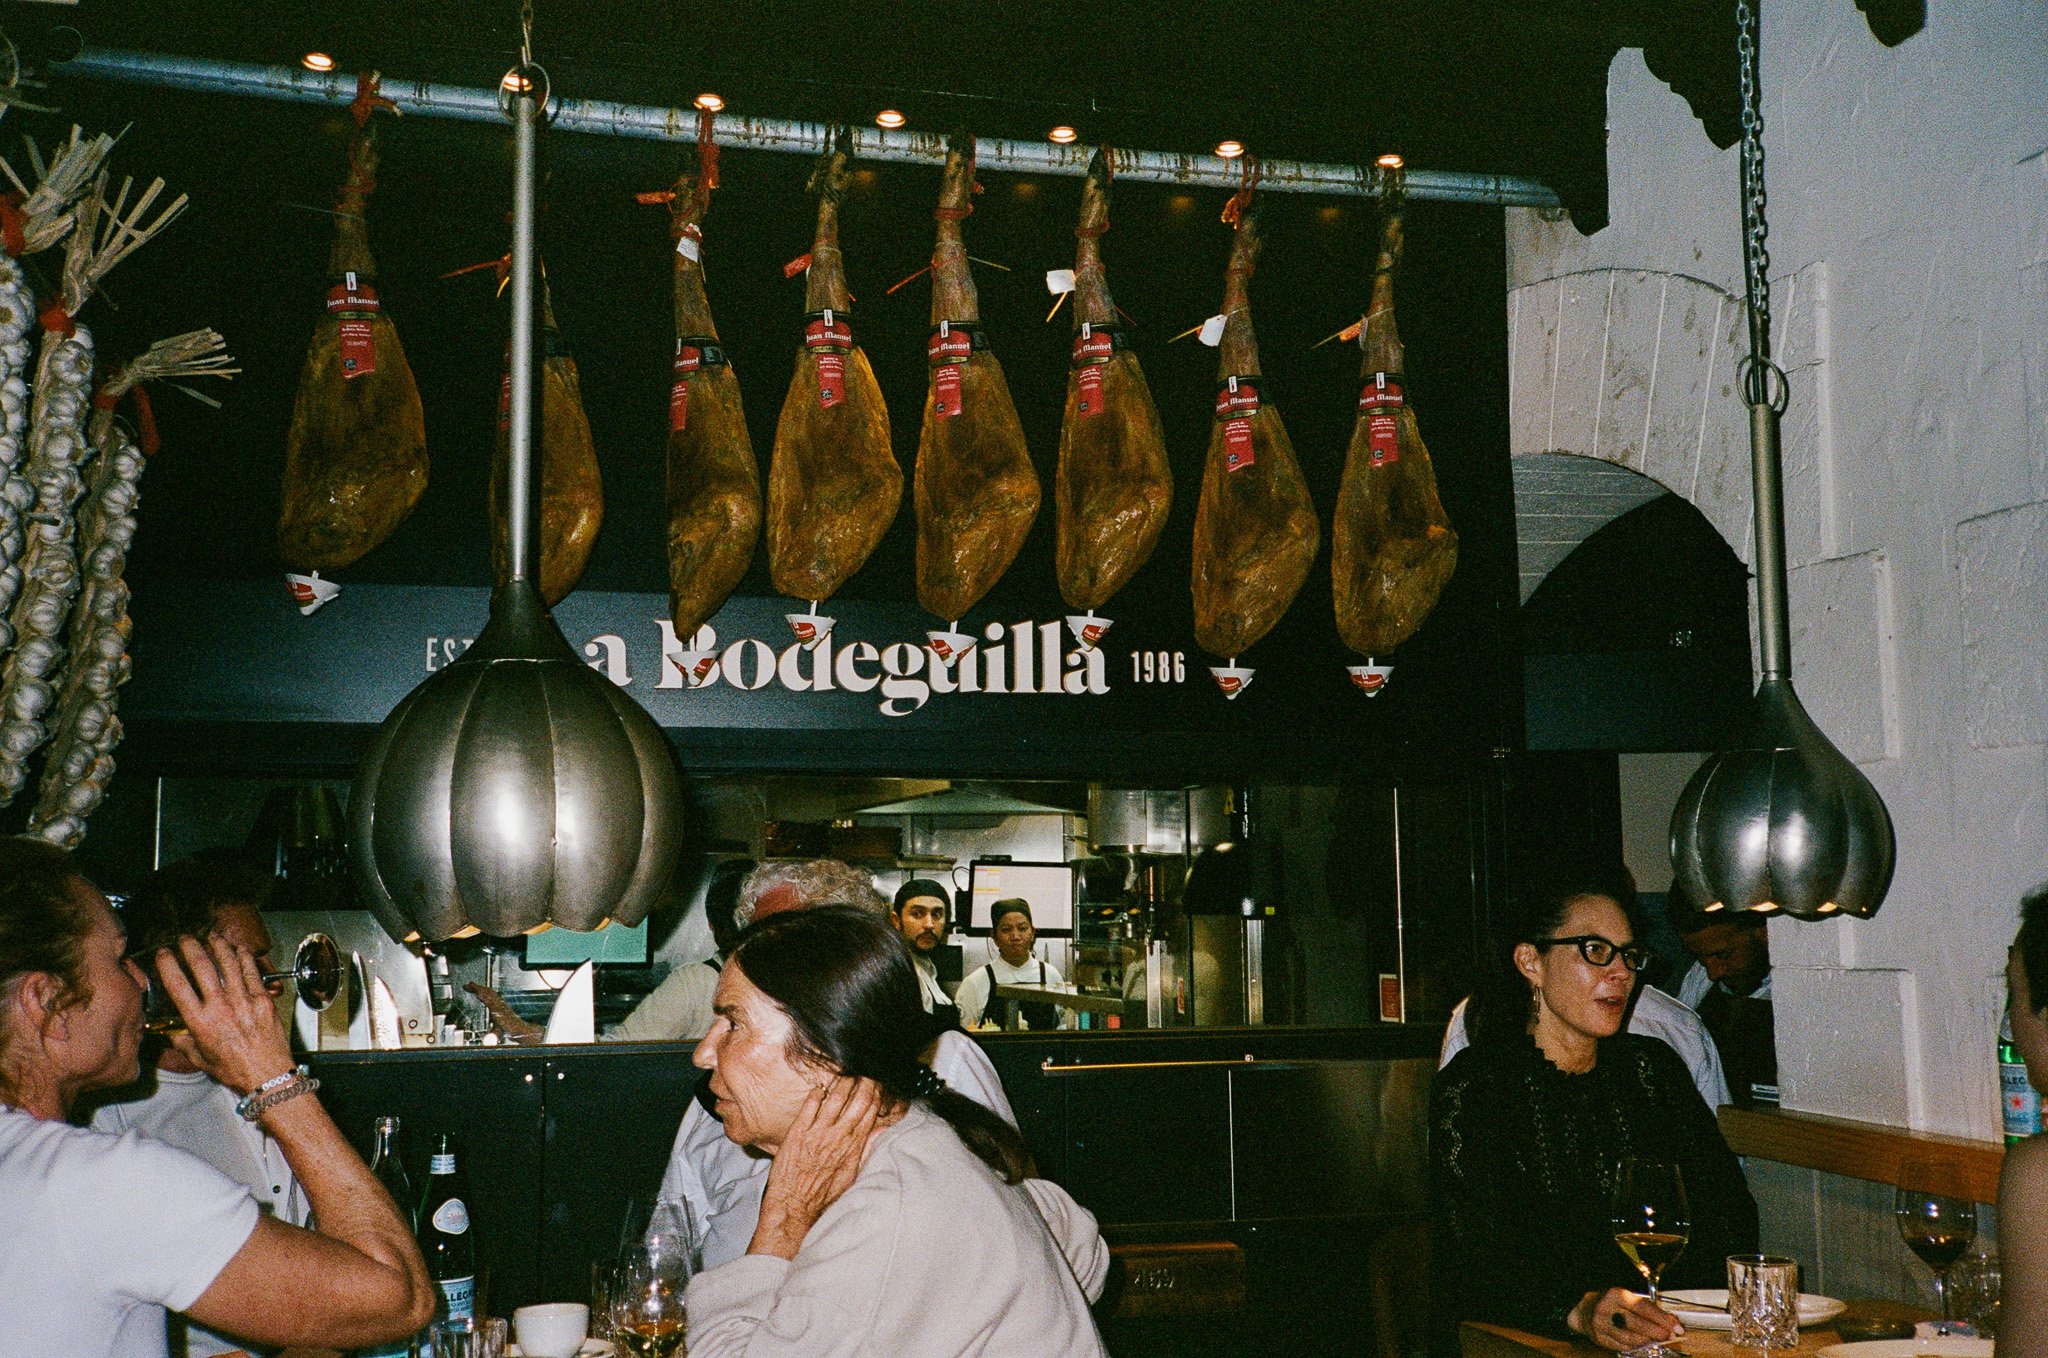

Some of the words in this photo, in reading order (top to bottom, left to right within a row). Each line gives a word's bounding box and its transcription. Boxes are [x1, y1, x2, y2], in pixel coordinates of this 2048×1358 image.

[327, 299, 345, 308] Juan
[806, 334, 823, 343] Juan
[824, 331, 852, 342] Manuel
[940, 342, 970, 351] Manuel
[1082, 342, 1112, 353] Manuel
[1229, 396, 1258, 405] Manuel
[1376, 393, 1403, 402] Manuel
[584, 633, 633, 688] a
[654, 619, 1111, 717] Bodeguilla
[1130, 650, 1186, 684] 1986
